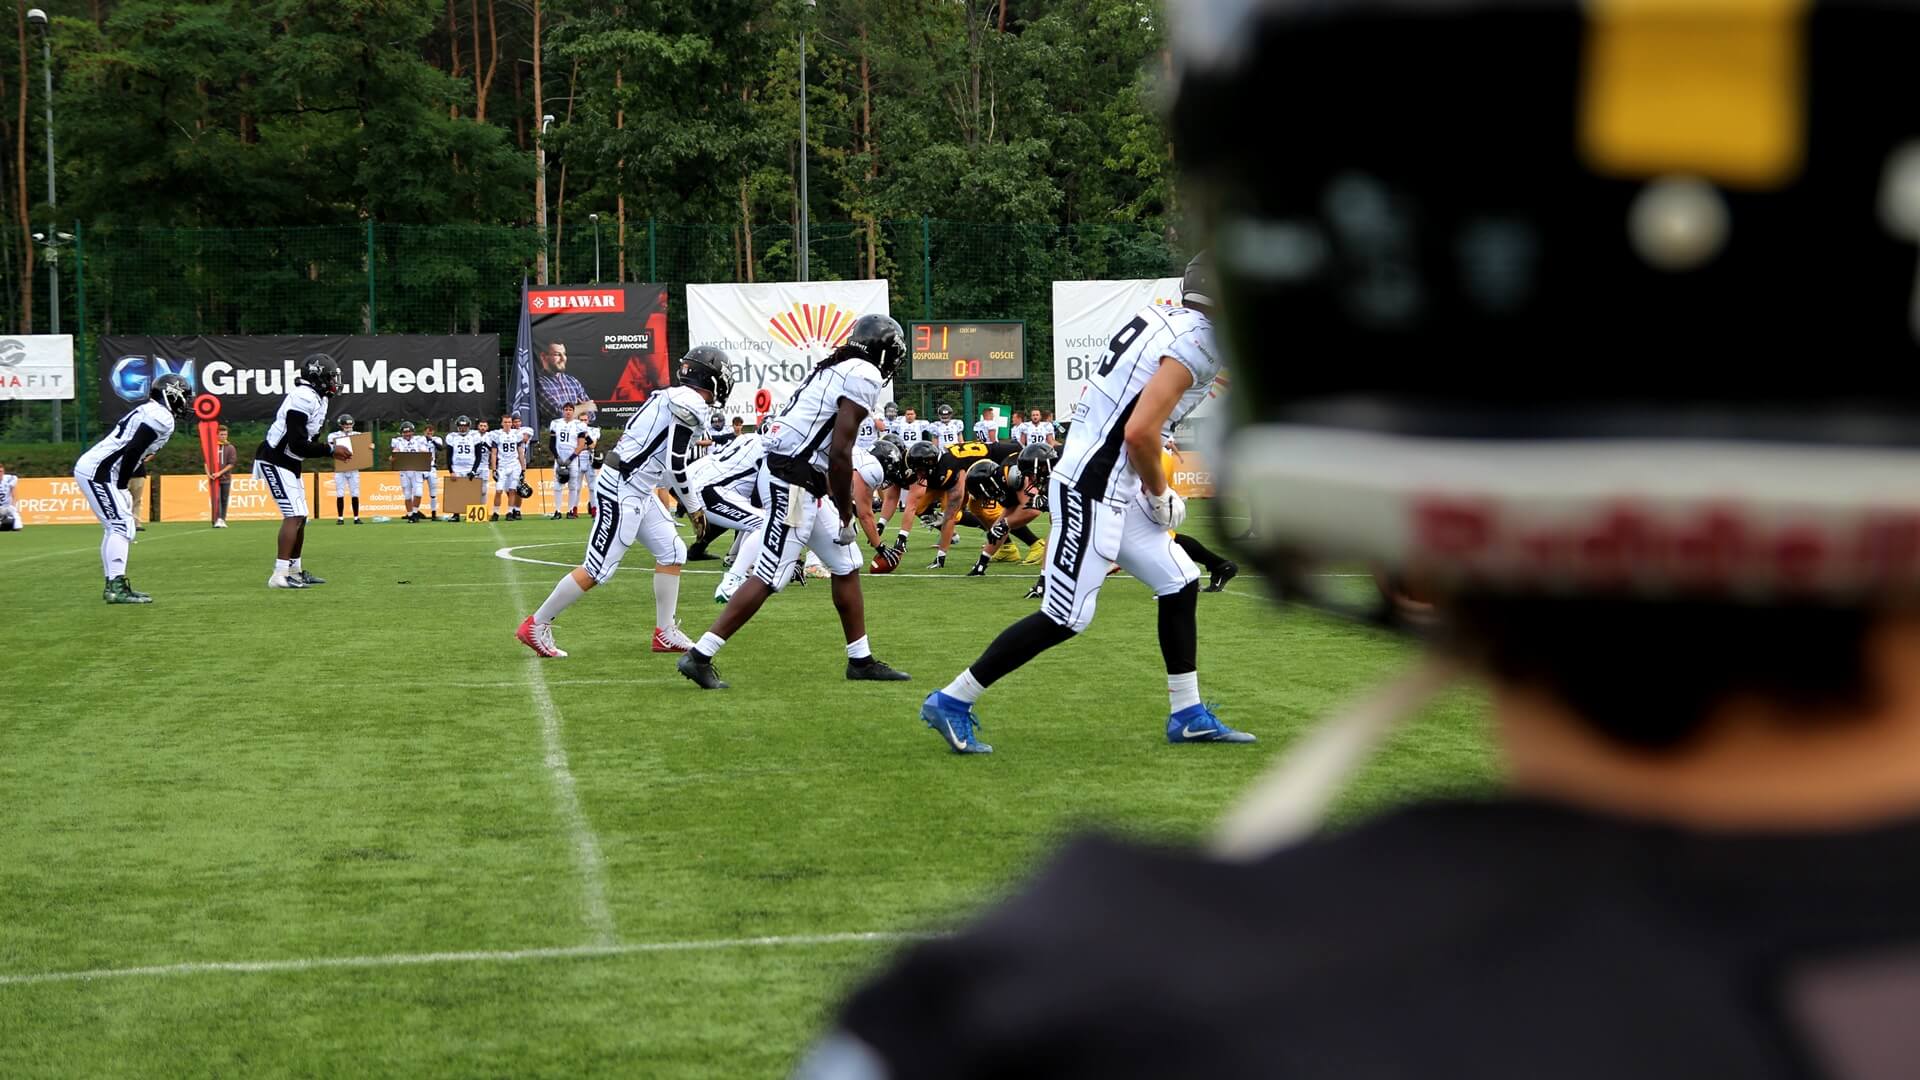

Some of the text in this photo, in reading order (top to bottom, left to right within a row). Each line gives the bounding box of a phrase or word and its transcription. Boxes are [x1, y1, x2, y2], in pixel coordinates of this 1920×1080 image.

[548, 295, 616, 308] BIAWAR
[916, 325, 948, 351] 31
[1065, 334, 1110, 348] wschod
[912, 352, 949, 360] GOSPODARZE
[989, 350, 1015, 360] GOŚCIE
[202, 358, 485, 396] Grub.Media
[731, 355, 812, 389] ałysto
[559, 432, 570, 442] 91
[903, 431, 917, 441] 62
[457, 444, 471, 454] 35
[502, 442, 516, 453] 85
[1173, 471, 1211, 485] PREZ
[50, 482, 81, 494] TAR
[199, 479, 266, 491] KCERT
[17, 499, 68, 512] PREZY
[209, 495, 268, 508] ENTY
[468, 507, 485, 521] 40
[712, 502, 748, 520] TOWICE
[594, 497, 613, 552] KATOWICE
[1060, 488, 1082, 574] KATOWICE
